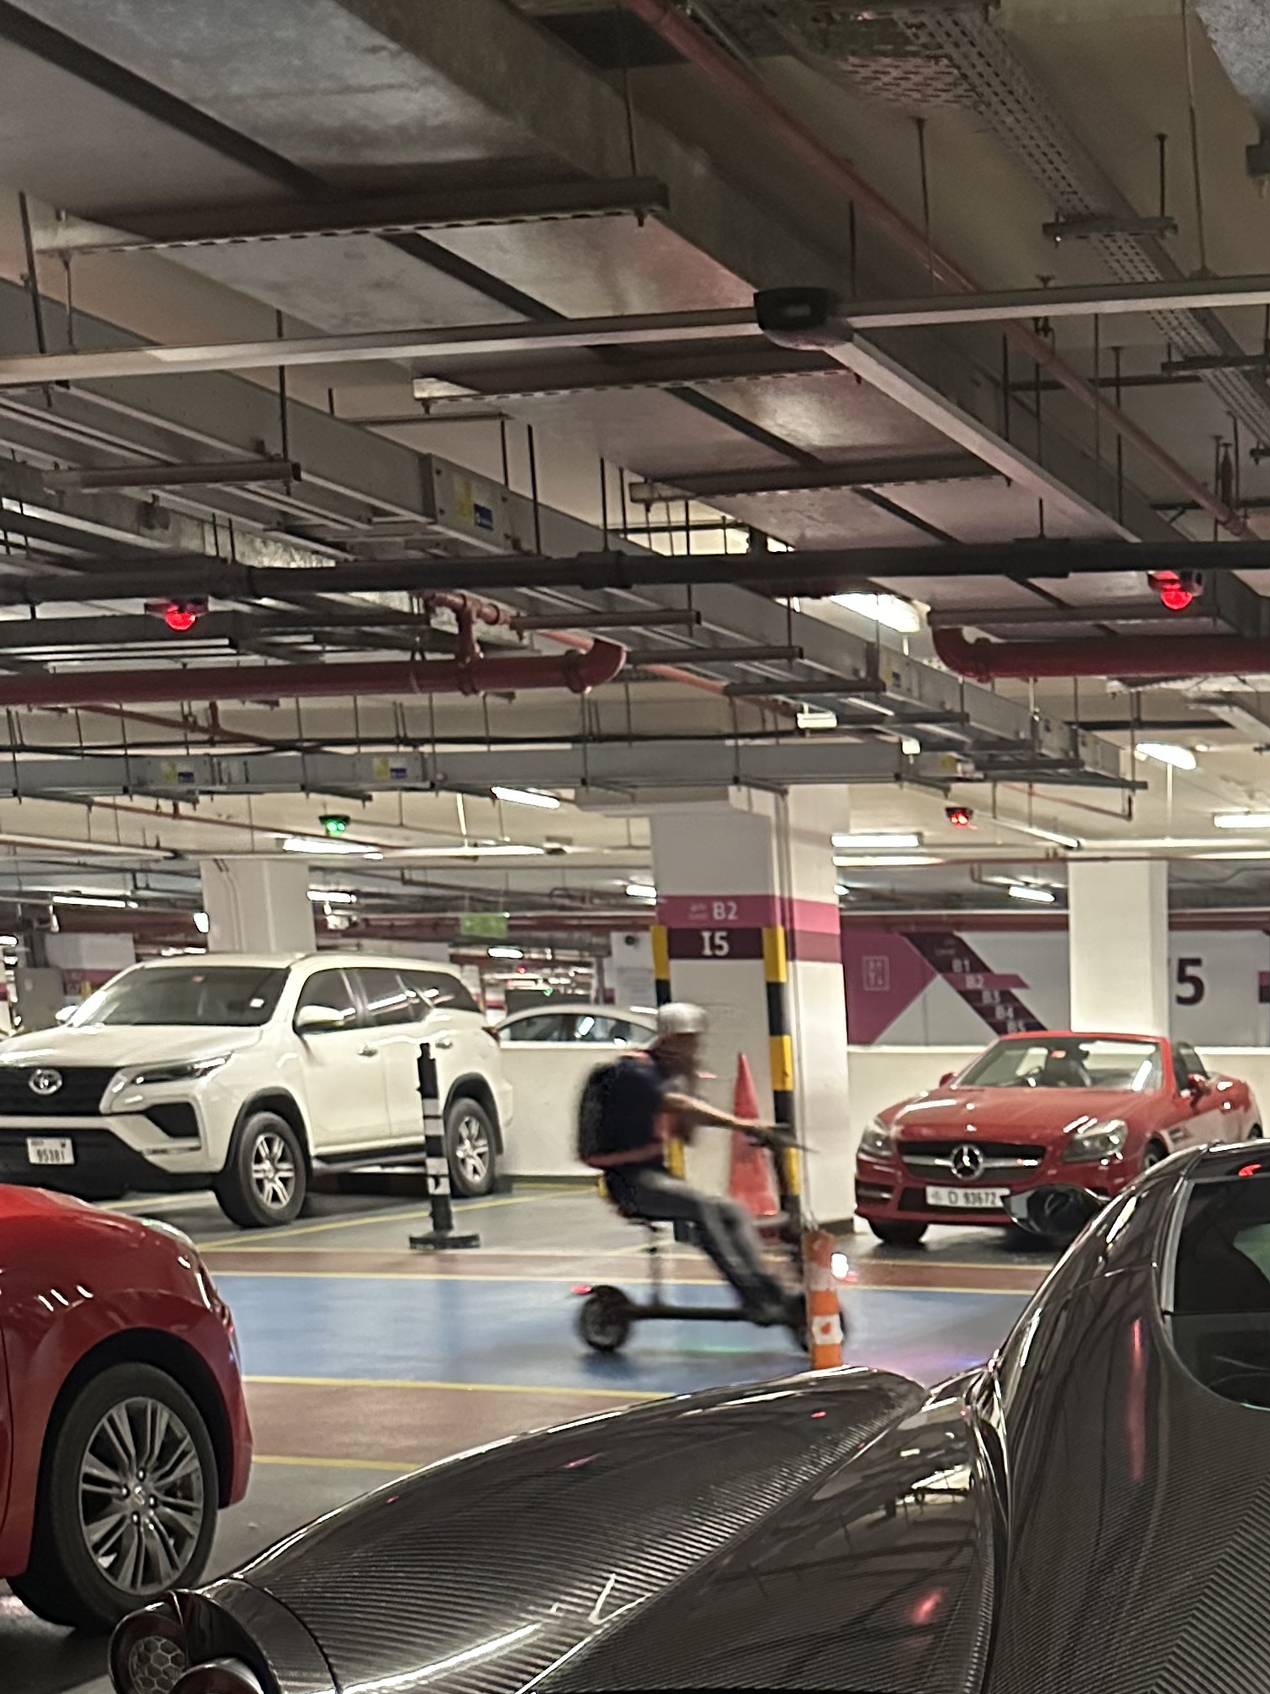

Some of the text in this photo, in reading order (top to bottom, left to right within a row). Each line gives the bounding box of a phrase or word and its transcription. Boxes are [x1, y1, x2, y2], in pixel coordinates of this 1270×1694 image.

[712, 902, 738, 920] B2
[701, 931, 729, 956] I5
[965, 975, 984, 988] B2
[947, 1190, 959, 1205] D
